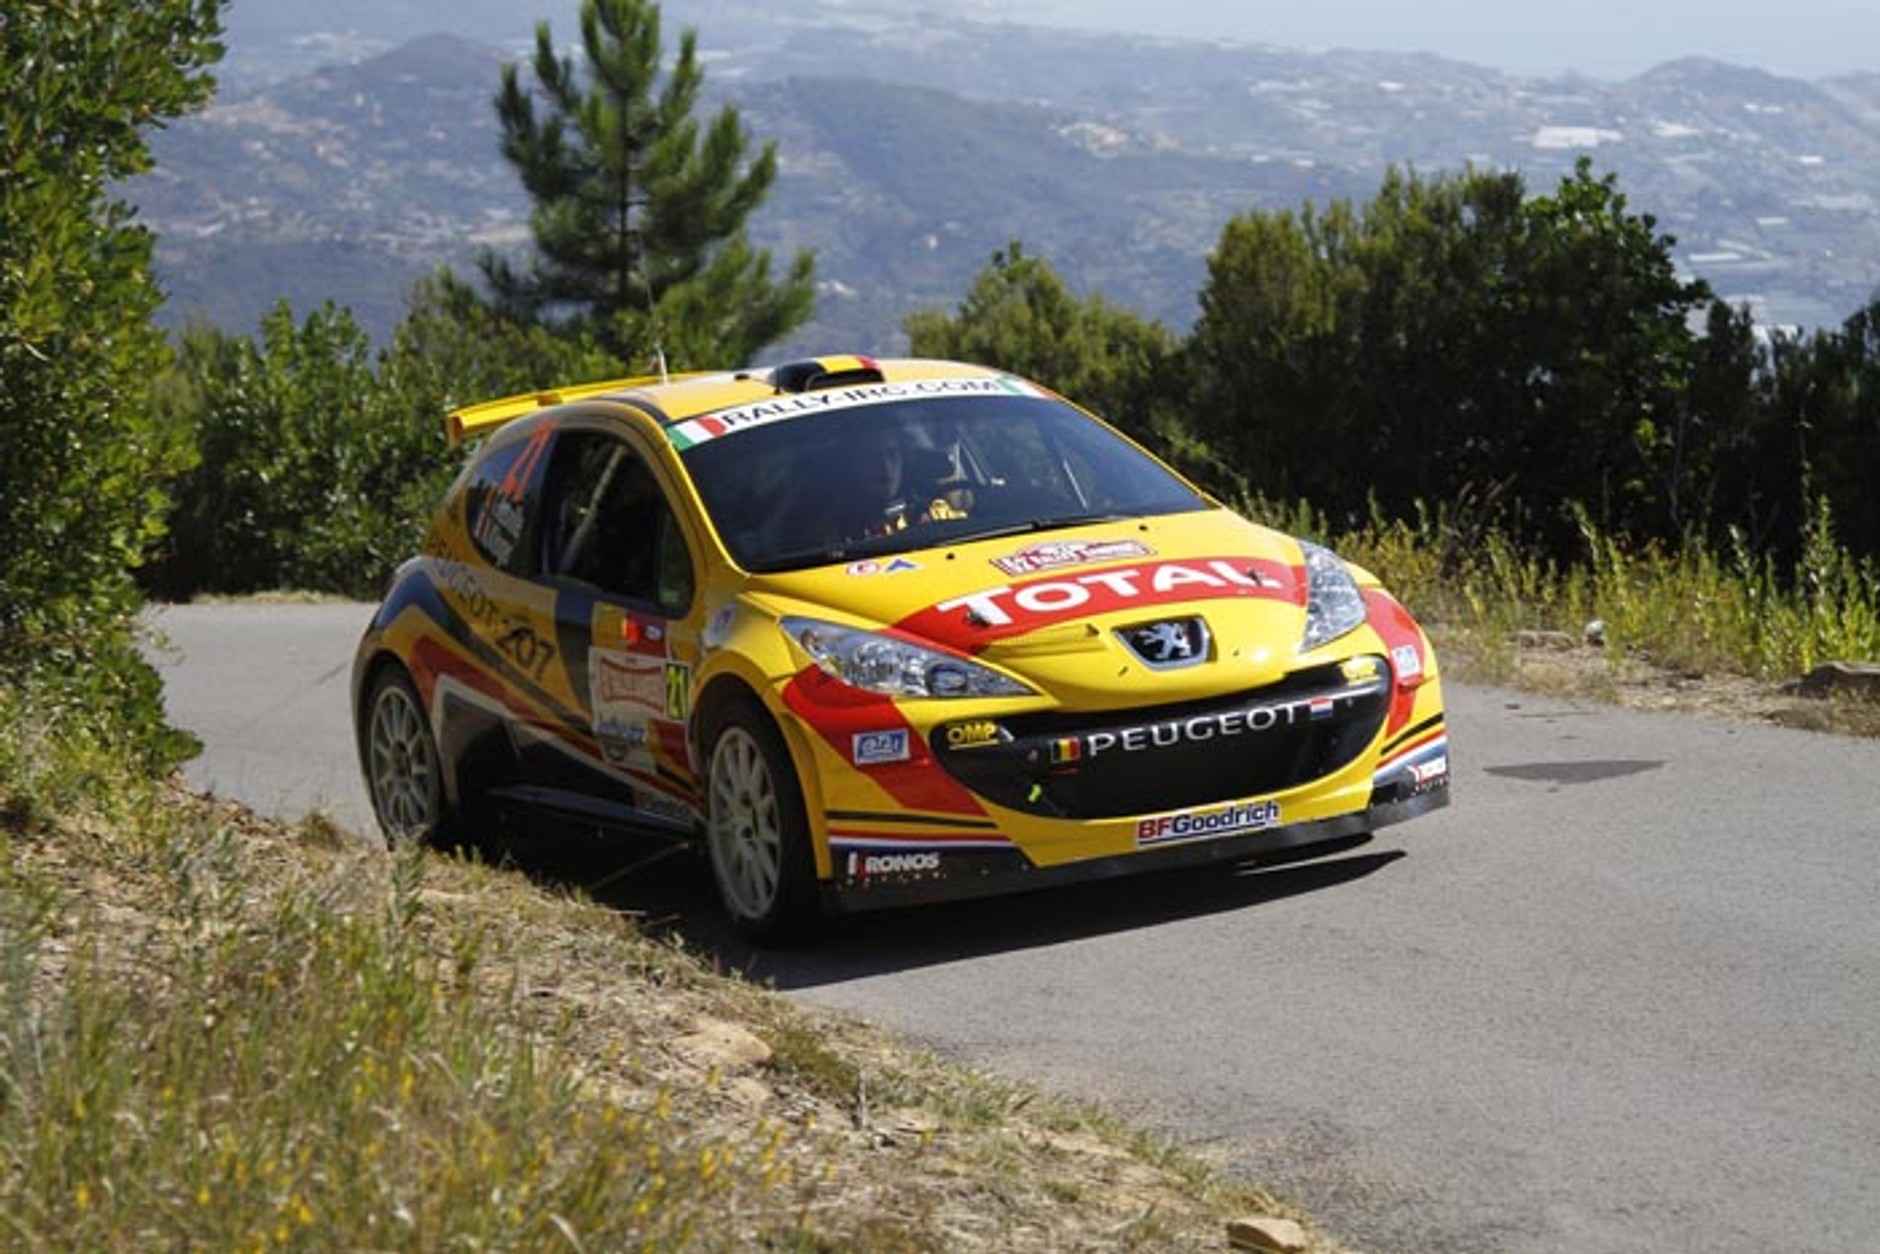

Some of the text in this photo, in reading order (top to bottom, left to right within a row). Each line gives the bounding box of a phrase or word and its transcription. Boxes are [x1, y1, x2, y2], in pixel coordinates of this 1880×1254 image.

[936, 559, 1284, 626] TOTAL
[495, 614, 557, 682] 207
[947, 721, 998, 744] OMP
[1087, 702, 1298, 757] PEUGEOT
[1138, 800, 1280, 841] BFGoodrich
